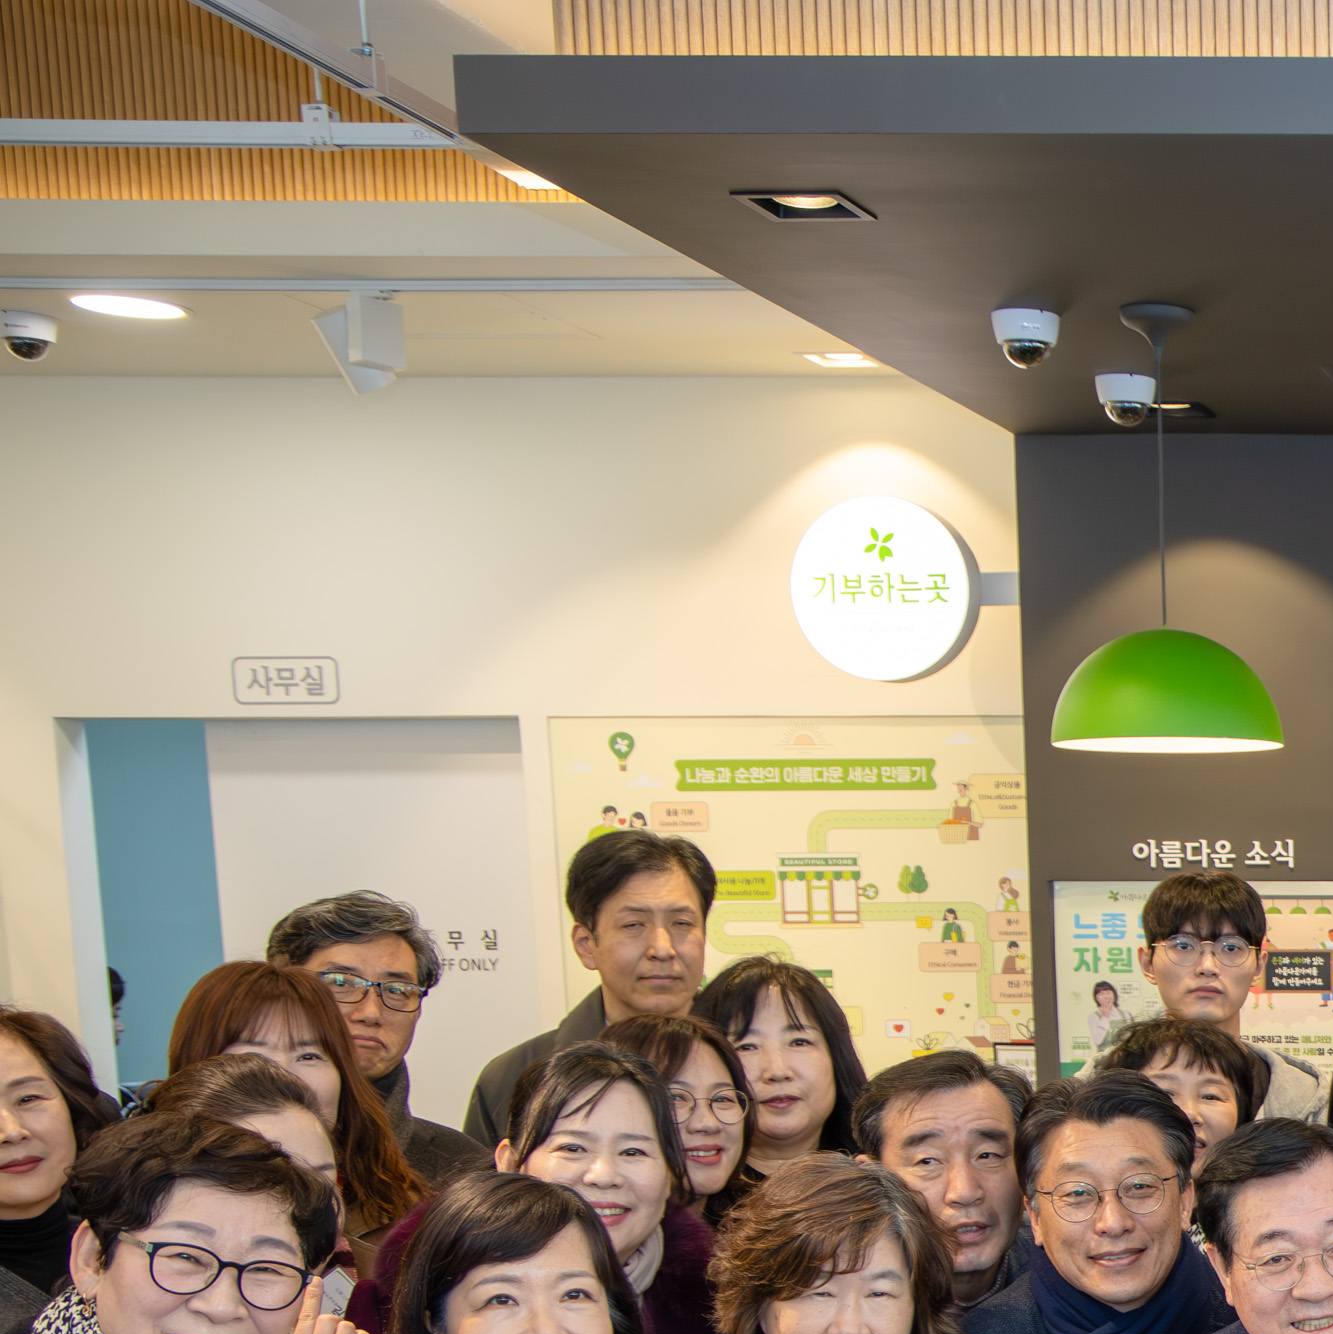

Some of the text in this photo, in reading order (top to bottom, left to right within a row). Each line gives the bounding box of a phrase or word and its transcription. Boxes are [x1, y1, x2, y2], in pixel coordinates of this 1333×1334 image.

[813, 572, 950, 604] 기부하는곳
[247, 664, 325, 697] 사무실
[685, 765, 927, 784] 나눔과 순환의 아름다운 세상 만들기
[784, 858, 853, 866] BEAUTIFUL STORE
[1132, 839, 1296, 869] 아름다운 소식
[459, 958, 498, 972] ONLY
